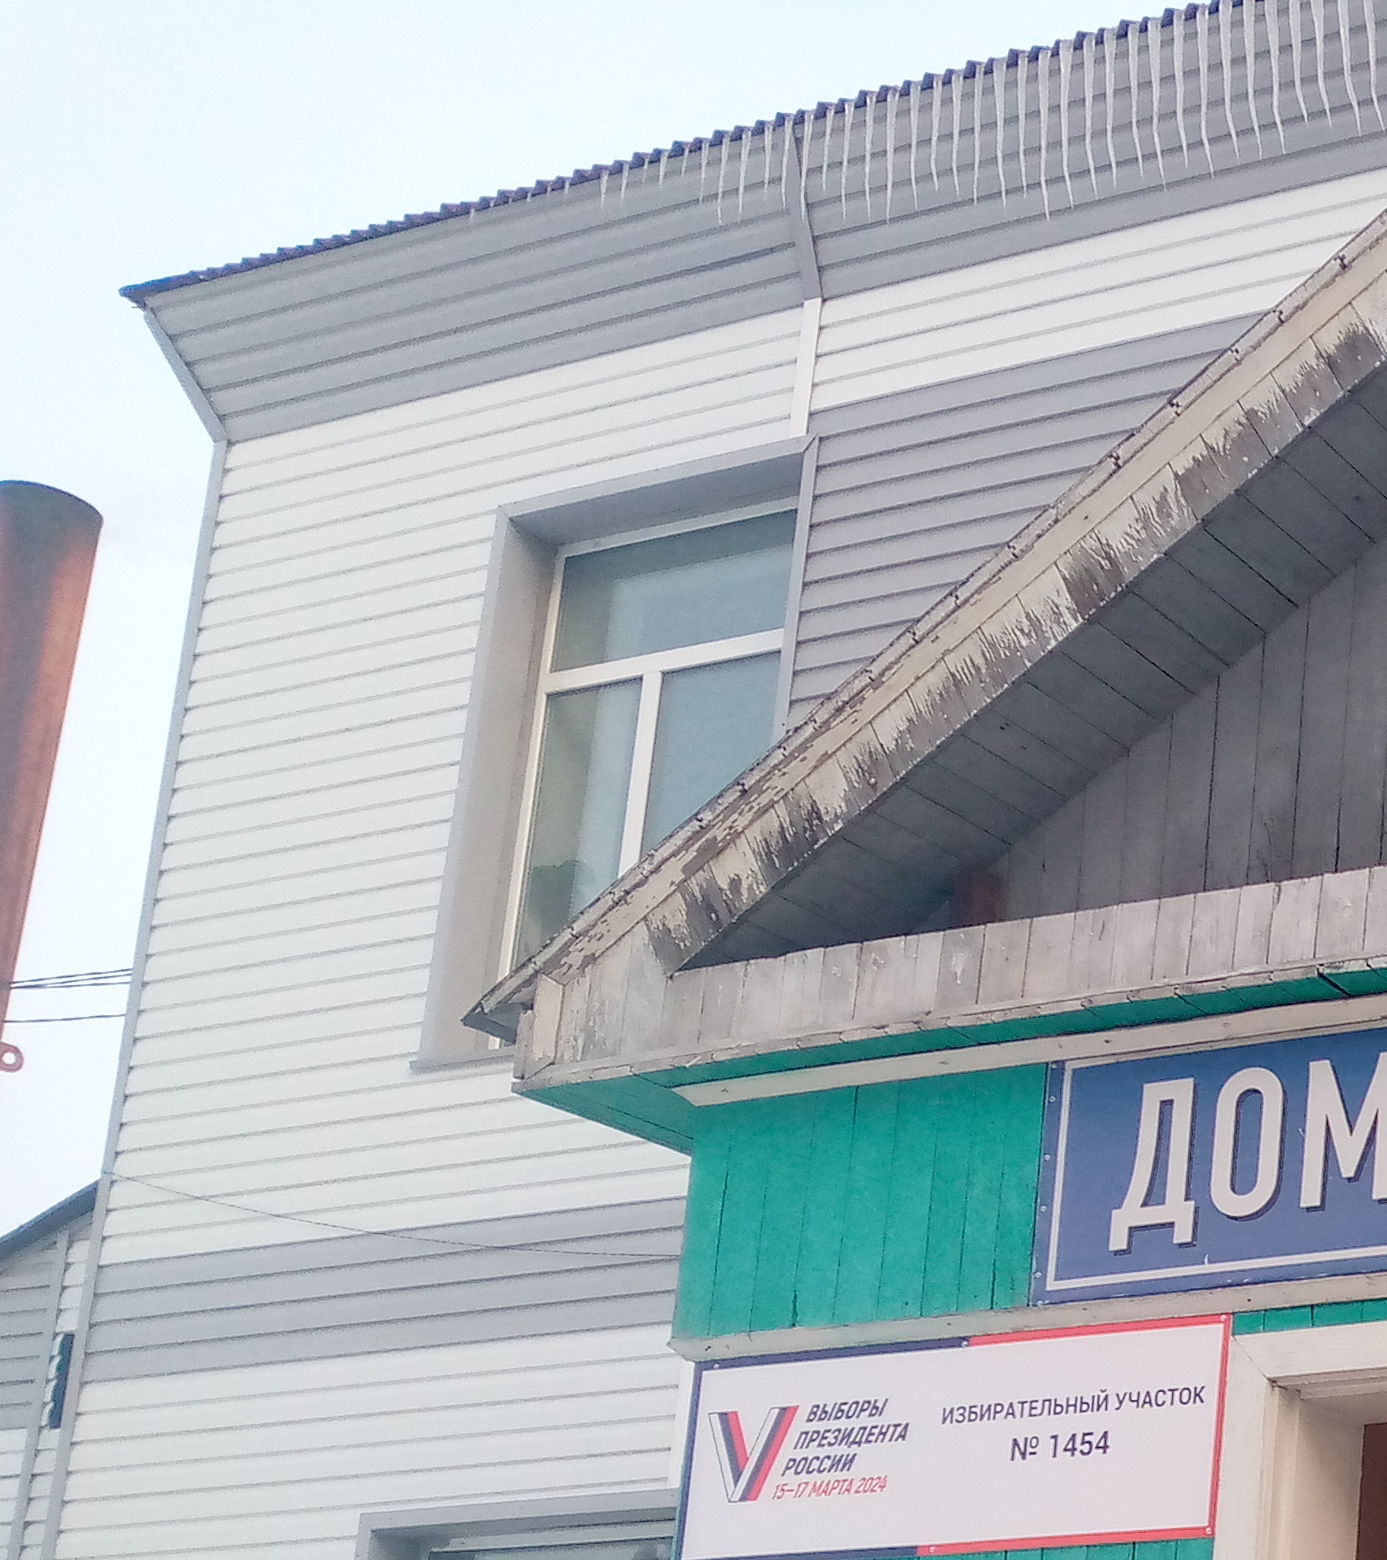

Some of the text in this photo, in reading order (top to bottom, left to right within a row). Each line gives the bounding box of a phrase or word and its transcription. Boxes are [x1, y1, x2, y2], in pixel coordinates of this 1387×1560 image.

[805, 1398, 889, 1423] ВЫБОРЫ
[941, 1385, 1206, 1426] ИЗБИРАТЕЛЬНЫЙ УЧАСТОК
[793, 1422, 910, 1450] ПРЕЗИДЕНТА
[1010, 1430, 1111, 1462] № 1454
[781, 1453, 857, 1477] РОССИИ
[808, 1478, 850, 1498] МАРТА
[853, 1475, 887, 1494] 2024
